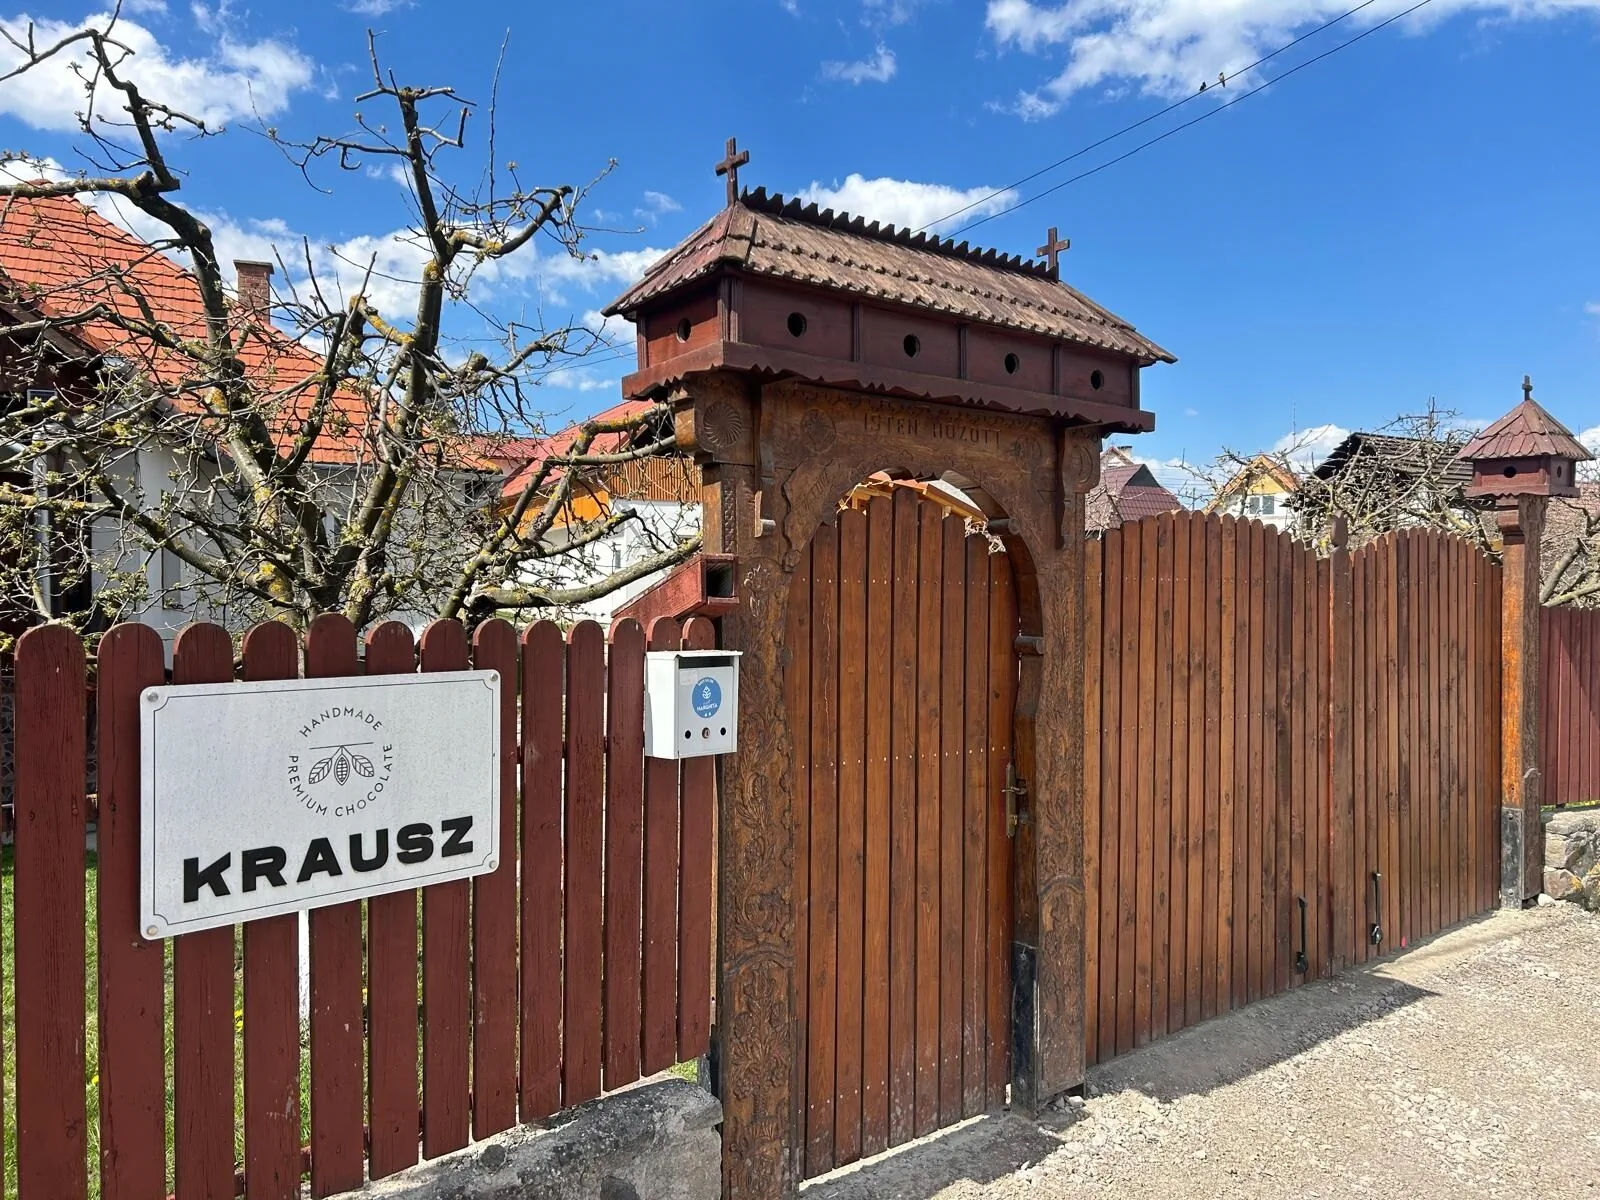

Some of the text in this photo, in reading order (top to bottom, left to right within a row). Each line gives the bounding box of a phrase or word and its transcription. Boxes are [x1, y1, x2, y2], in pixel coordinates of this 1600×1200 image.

[864, 412, 1001, 449] ISTEN HOZOTT
[299, 707, 382, 737] HANDMADE
[288, 744, 393, 816] PREMIUM CHOCOLATE
[183, 815, 474, 903] KRAUSZ
